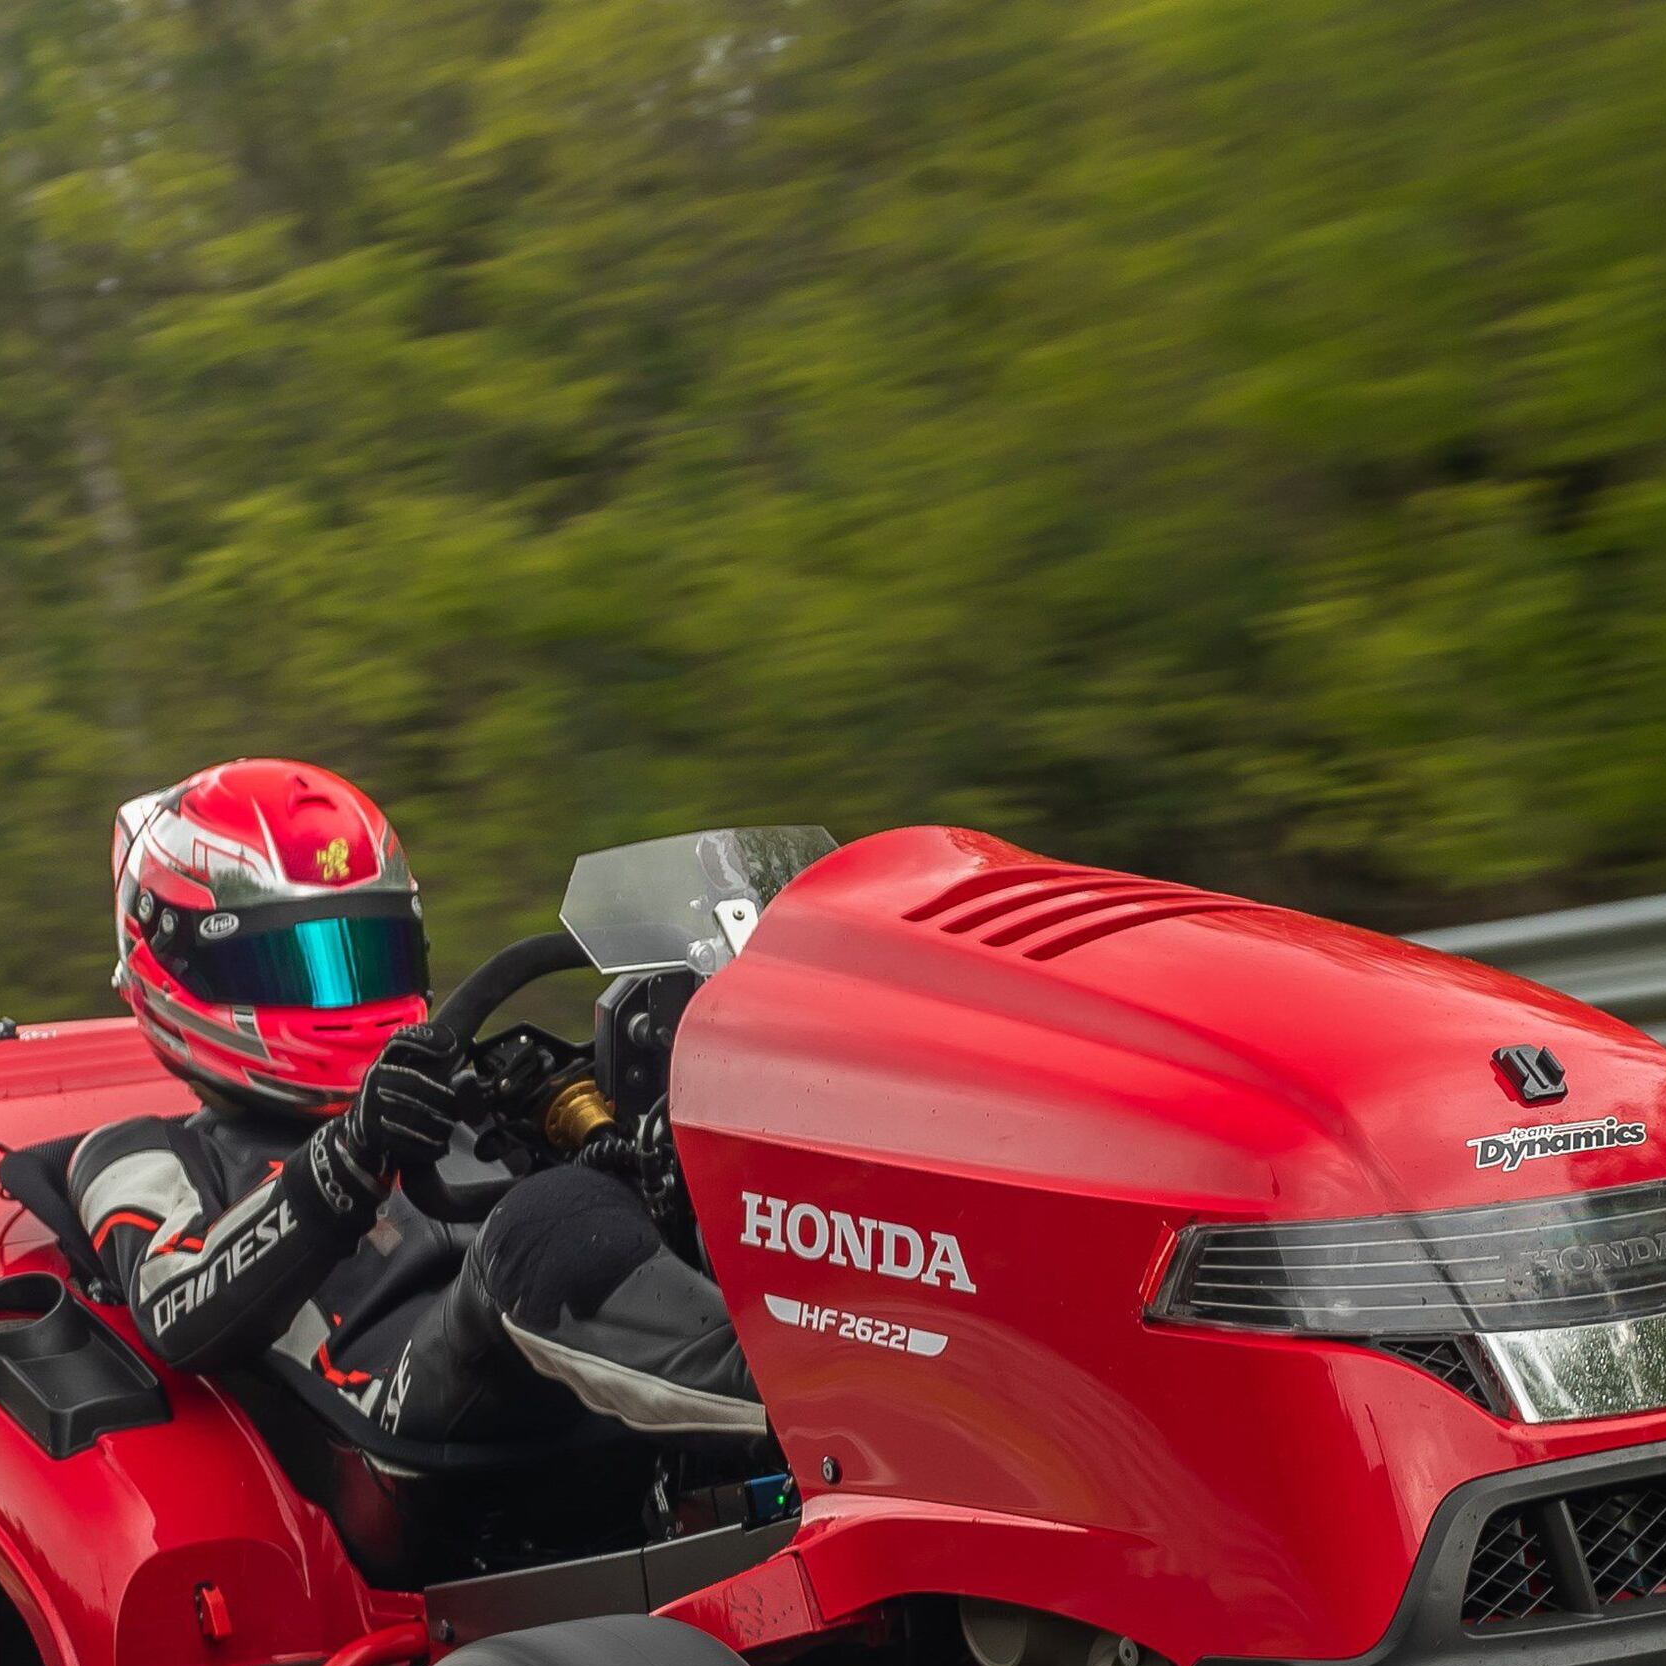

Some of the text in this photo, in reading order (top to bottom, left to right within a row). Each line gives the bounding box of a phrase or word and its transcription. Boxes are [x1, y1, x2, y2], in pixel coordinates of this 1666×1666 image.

[1478, 1117, 1645, 1169] Dynamics
[1511, 1125, 1553, 1140] team
[739, 1190, 977, 1294] HONDA
[838, 1312, 907, 1351] 2622
